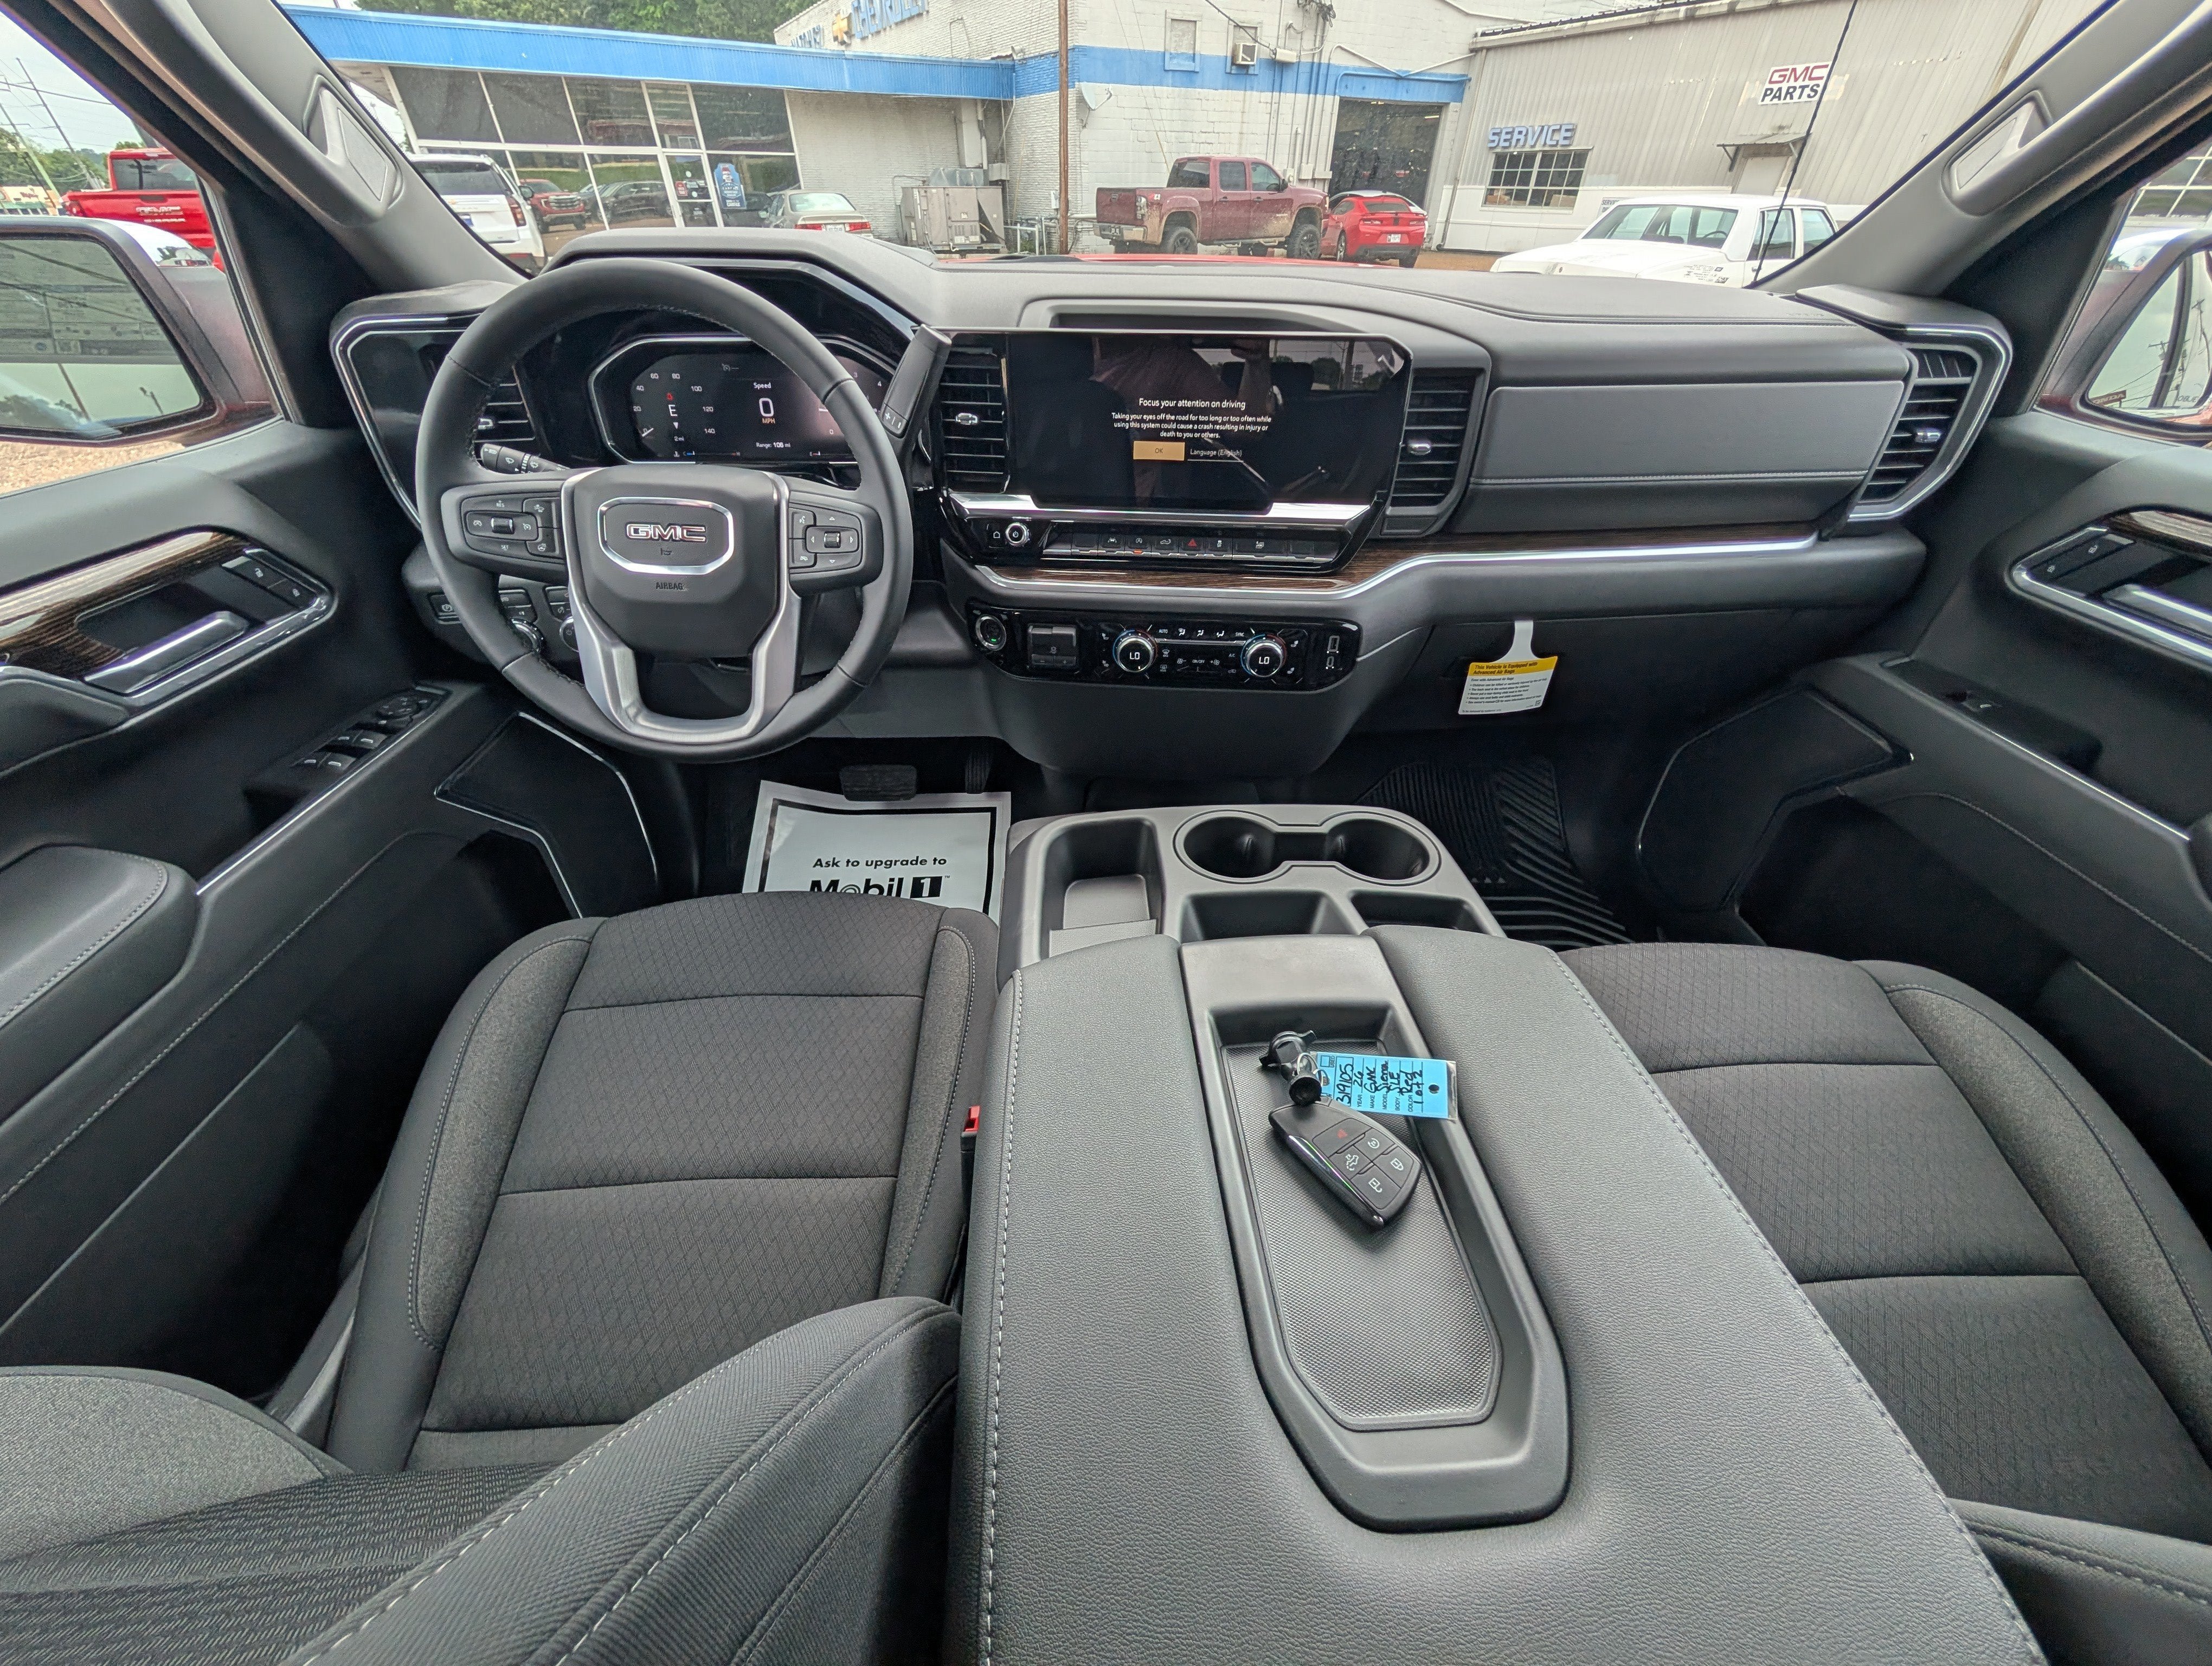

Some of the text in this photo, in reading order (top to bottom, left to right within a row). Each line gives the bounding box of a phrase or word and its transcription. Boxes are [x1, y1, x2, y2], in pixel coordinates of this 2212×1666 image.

[852, 0, 929, 39] CHEVRO
[1768, 64, 1829, 85] GMC
[1761, 84, 1820, 102] PARTS
[1488, 124, 1576, 148] SERVICE
[668, 405, 678, 416] E
[759, 398, 774, 416] 0
[1139, 398, 1160, 406] Focus
[1161, 400, 1176, 409] your
[1178, 399, 1210, 407] attention
[1221, 399, 1246, 411] driving
[1111, 412, 1129, 420] Taking
[1210, 414, 1222, 422] long
[1214, 423, 1238, 432] resulting
[1190, 448, 1242, 458] Language (English)
[625, 522, 706, 542] GMC
[813, 856, 947, 869] Ask to upgrade to
[809, 877, 904, 898] Mobil
[1336, 1063, 1354, 1104] 319105
[1354, 1071, 1364, 1087] 26
[1364, 1066, 1377, 1093] GMC
[1388, 1072, 1401, 1092] SLE
[1399, 1070, 1414, 1095] Red
